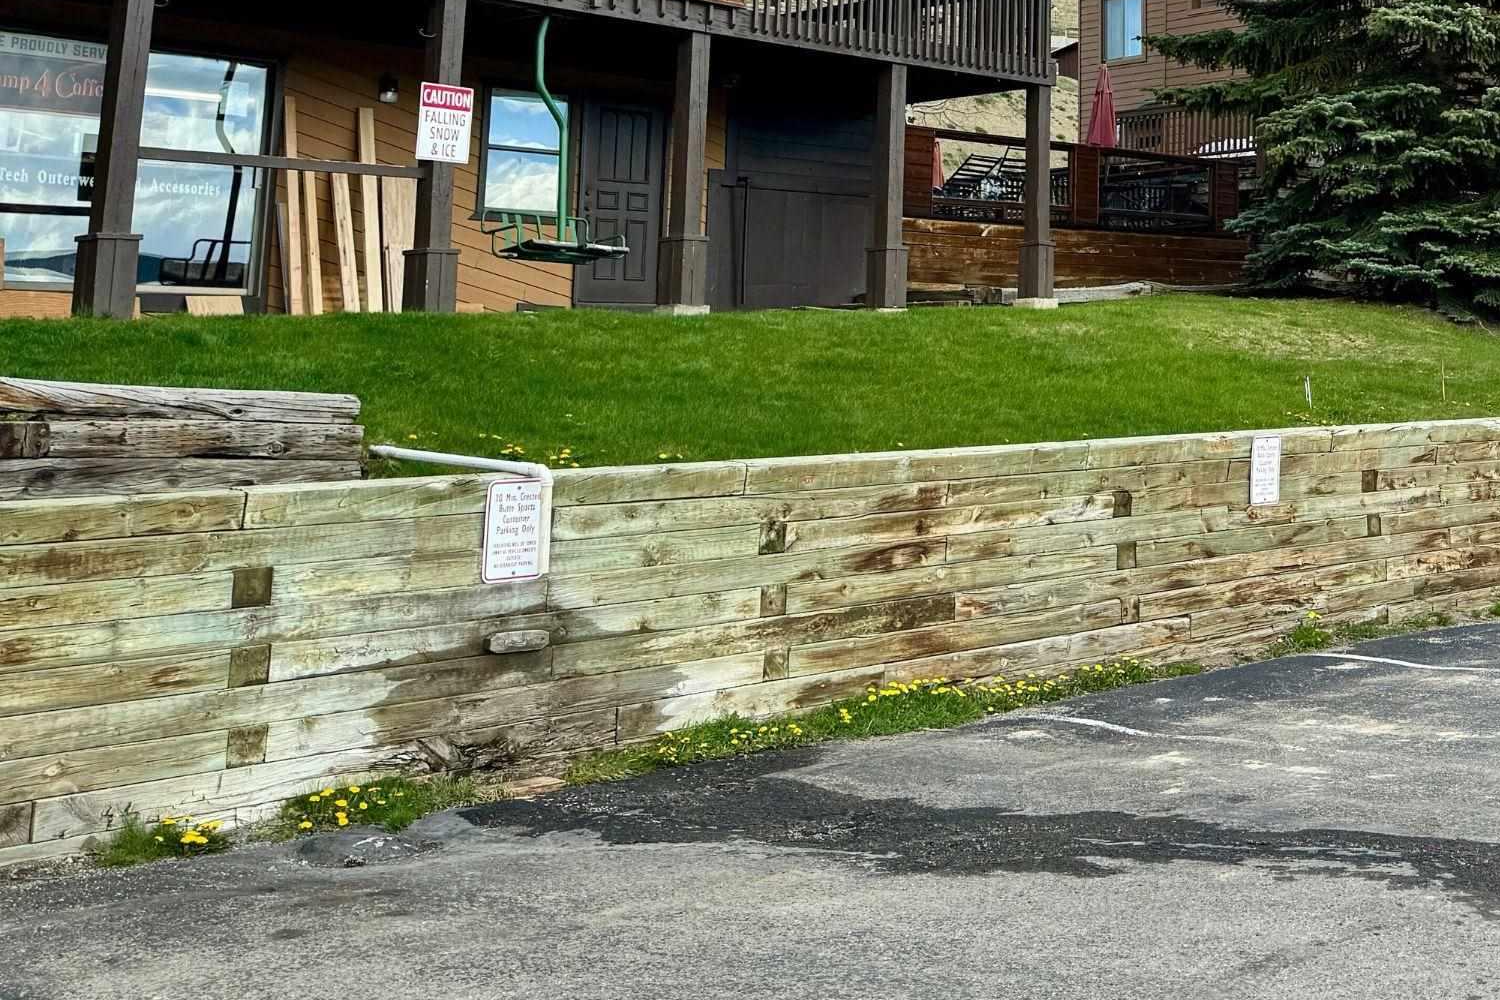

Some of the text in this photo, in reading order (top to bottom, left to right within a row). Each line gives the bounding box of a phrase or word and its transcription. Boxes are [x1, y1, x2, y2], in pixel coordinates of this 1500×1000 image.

[11, 36, 68, 55] PROUDLY
[72, 44, 106, 60] SERV
[423, 88, 471, 108] CAUTION
[425, 110, 466, 127] FALLING
[429, 126, 460, 141] SNOW
[431, 143, 457, 158] & ICE
[38, 170, 95, 188] Outerwe
[150, 178, 220, 198] Accessories
[496, 524, 535, 536] Parking Only
